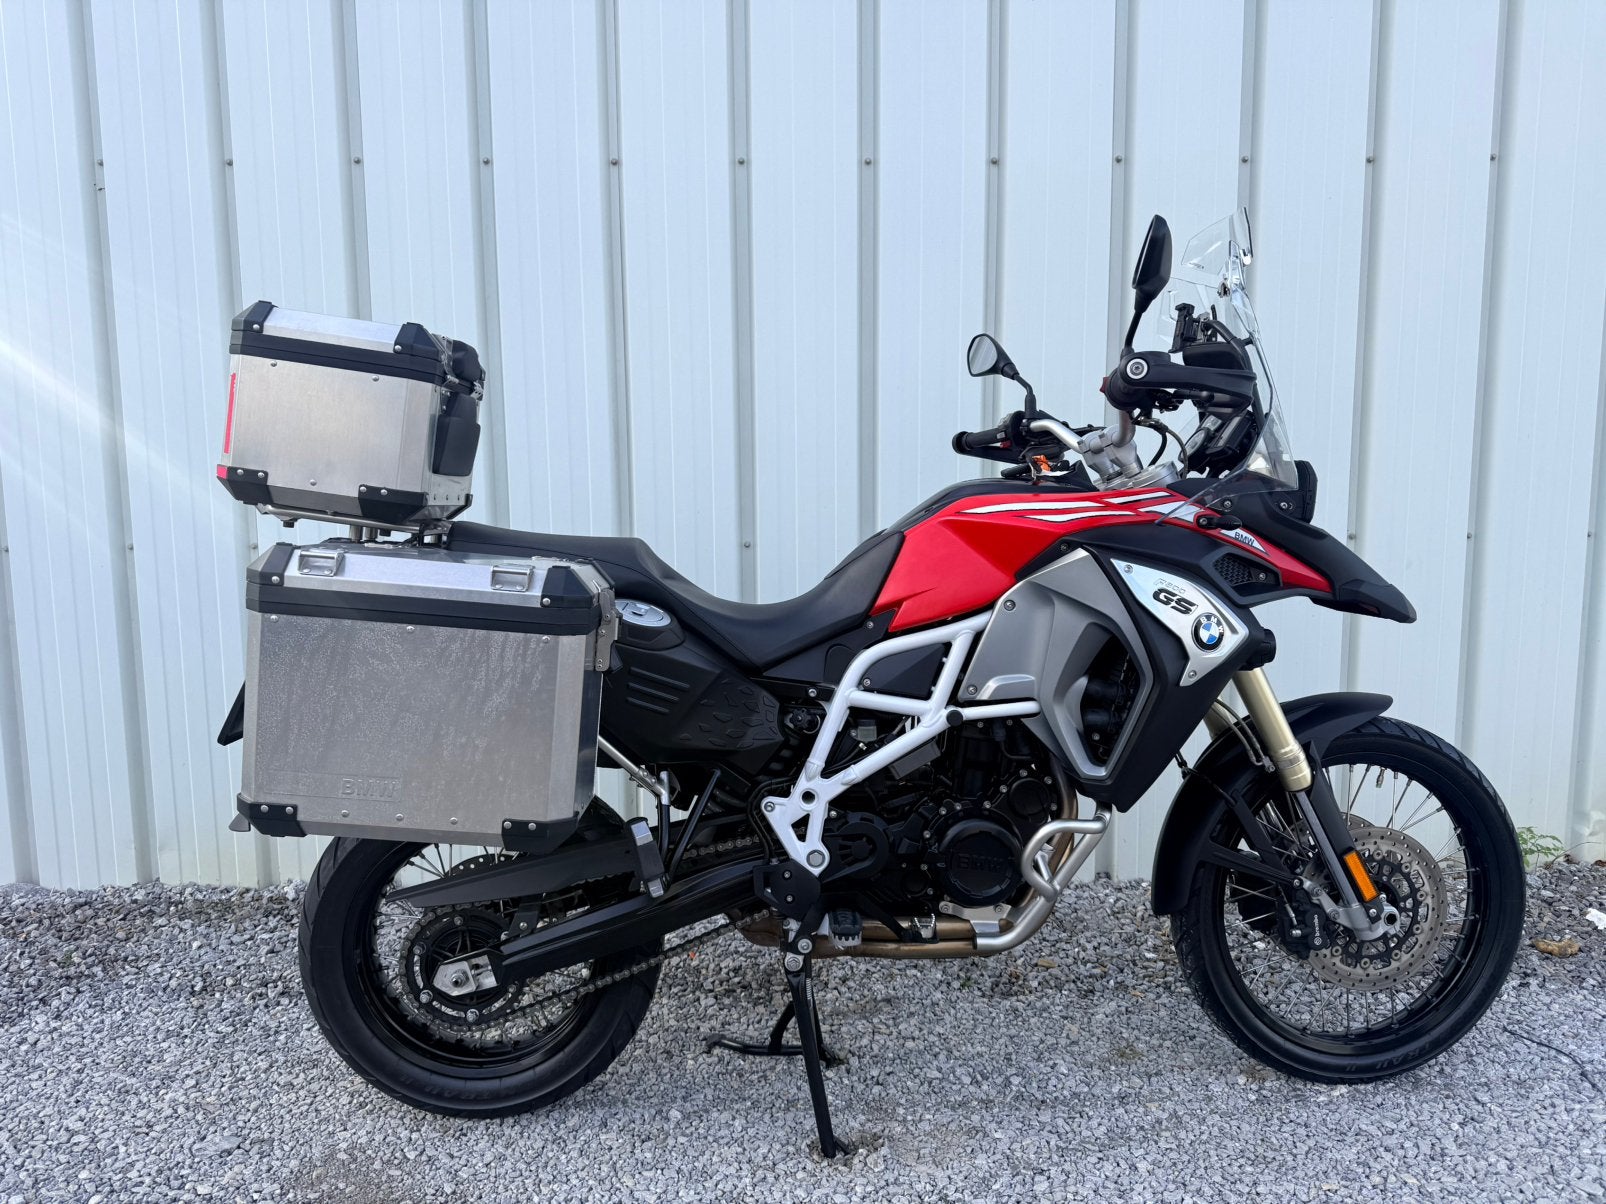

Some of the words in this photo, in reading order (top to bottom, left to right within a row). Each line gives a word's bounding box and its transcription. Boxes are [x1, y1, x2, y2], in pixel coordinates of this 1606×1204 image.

[1234, 531, 1255, 547] BMW
[1152, 587, 1198, 615] GS
[341, 778, 400, 798] BMW
